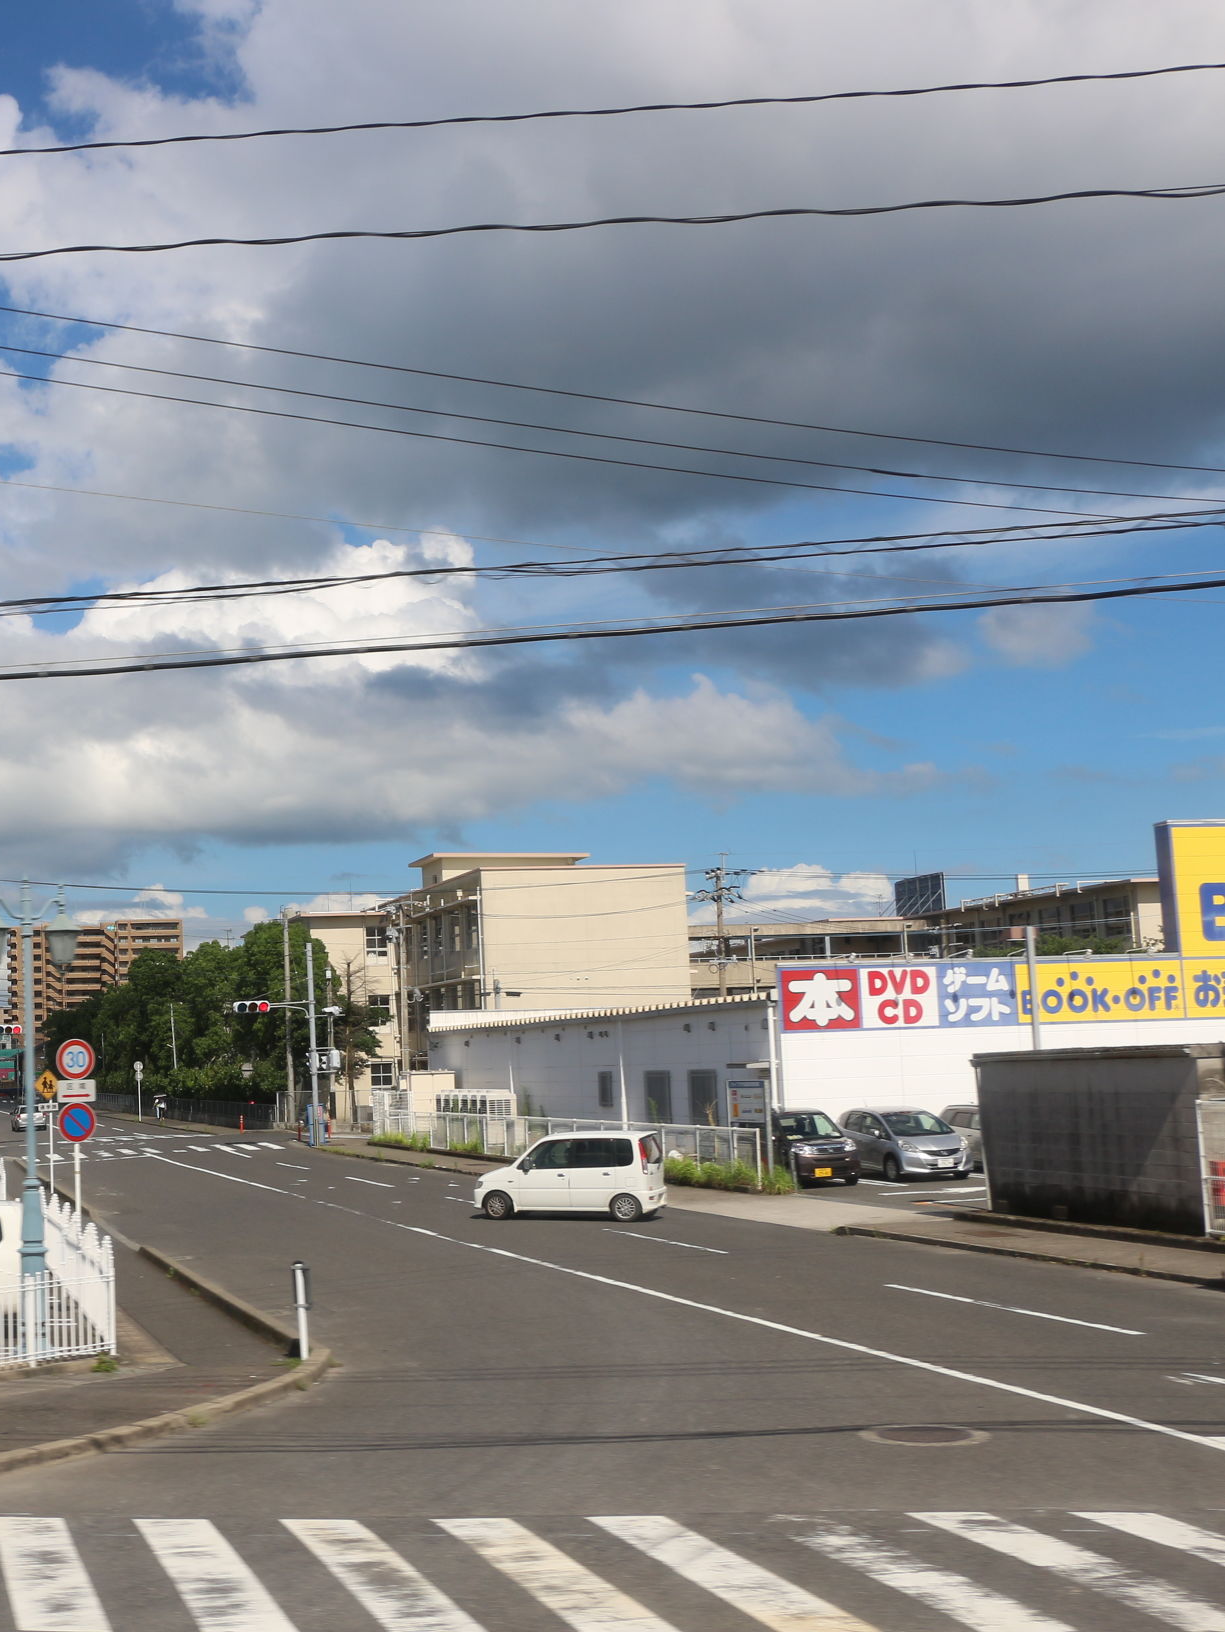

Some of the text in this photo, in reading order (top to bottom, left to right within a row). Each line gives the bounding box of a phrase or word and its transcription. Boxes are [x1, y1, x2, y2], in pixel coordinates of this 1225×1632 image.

[868, 969, 930, 996] DVD
[943, 967, 1009, 993] ゲーム
[1192, 969, 1225, 1008] お
[788, 972, 855, 1027] 本
[878, 999, 923, 1024] CD
[944, 997, 1011, 1022] ソフト
[66, 1051, 86, 1068] 30
